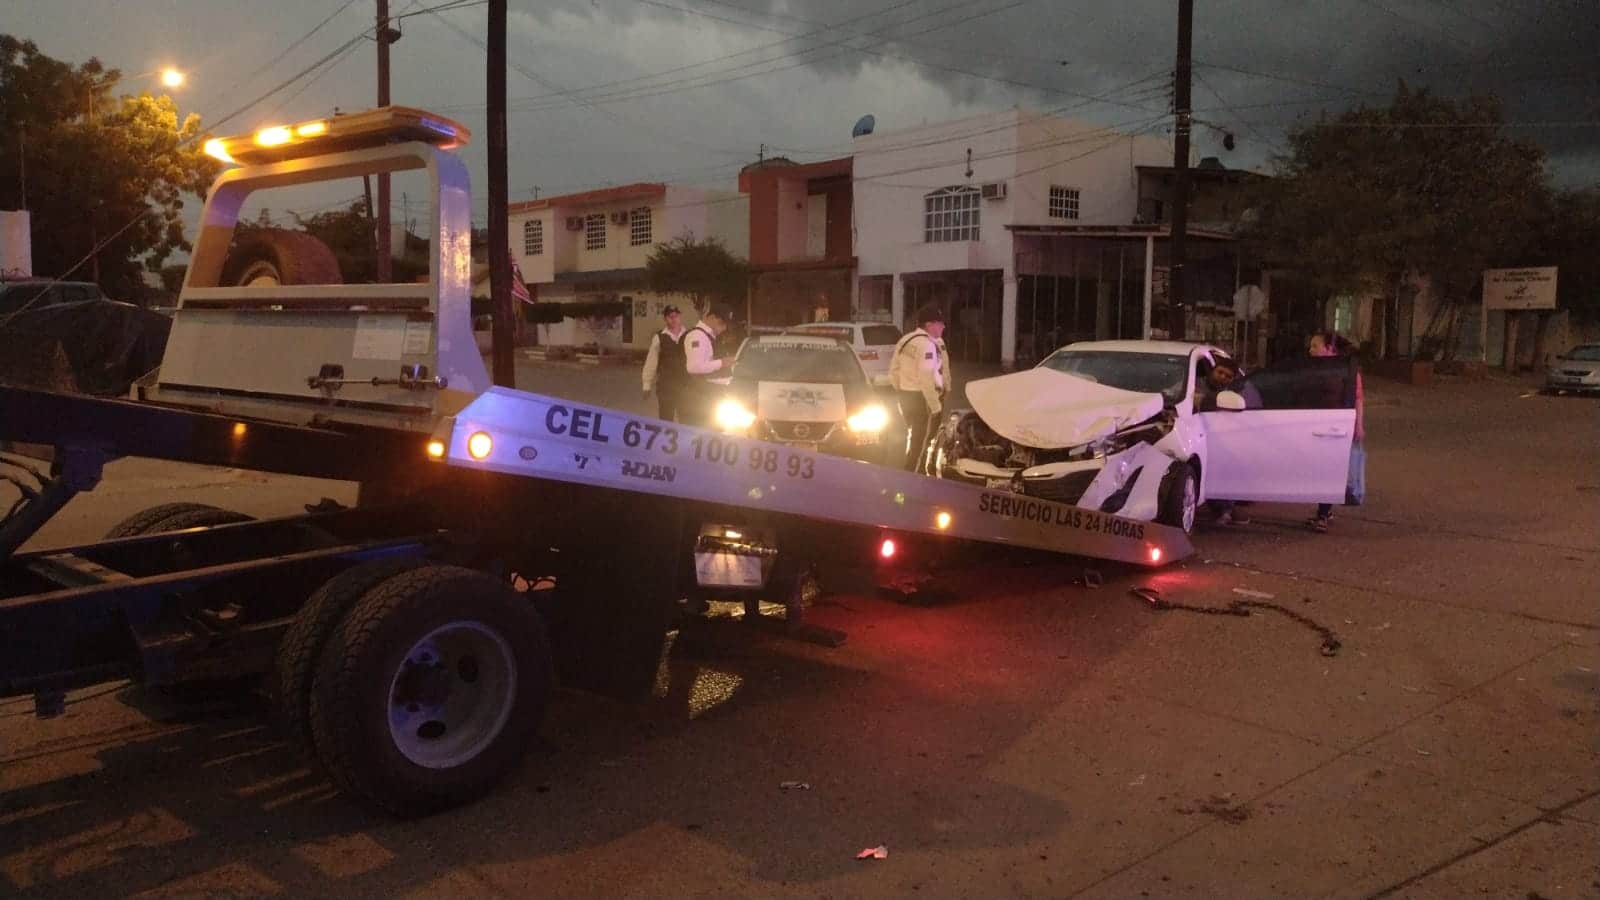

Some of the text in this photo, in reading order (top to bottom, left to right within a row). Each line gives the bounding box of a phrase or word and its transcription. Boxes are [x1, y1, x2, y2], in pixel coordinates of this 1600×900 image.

[545, 405, 815, 480] CEL 673 100 98 93
[979, 493, 1145, 540] SERVICIO LAS 24 HORAS
